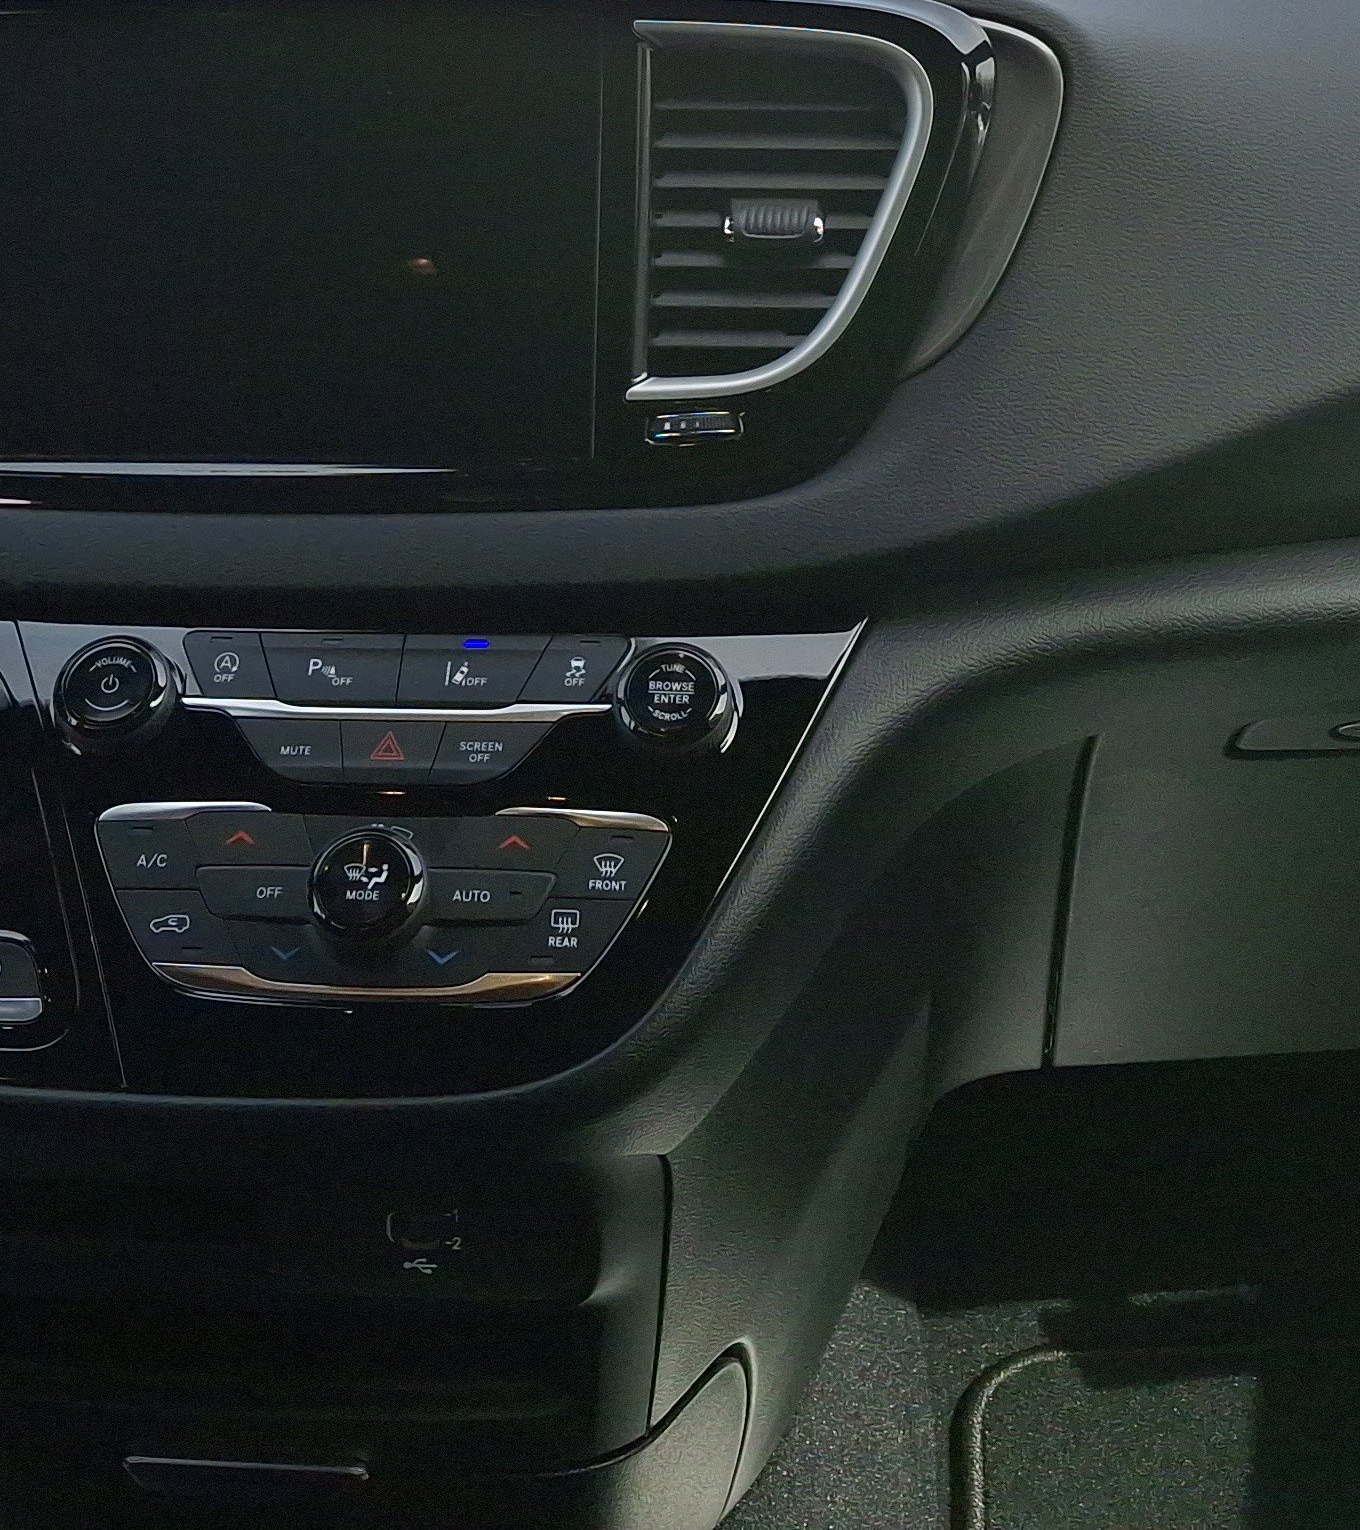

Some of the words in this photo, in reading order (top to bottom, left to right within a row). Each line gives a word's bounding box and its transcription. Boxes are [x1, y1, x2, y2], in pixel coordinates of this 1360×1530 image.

[95, 657, 133, 668] VOLUME
[660, 662, 687, 673] TUNE
[214, 673, 235, 683] OFF
[331, 676, 354, 686] OFF
[466, 676, 489, 687] OFF
[564, 677, 586, 687] OFF
[648, 680, 695, 692] BROWSE
[653, 694, 690, 705] ENTER
[652, 709, 689, 721] SCROLL
[279, 745, 312, 755] MUTE
[459, 740, 504, 751] SCREEN
[468, 753, 491, 763] OFF
[136, 853, 168, 868] A/C
[588, 879, 627, 891] FRONT
[256, 886, 283, 899] OFF
[345, 890, 380, 901] MODE
[452, 889, 491, 903] AUTO
[548, 936, 578, 948] REAR
